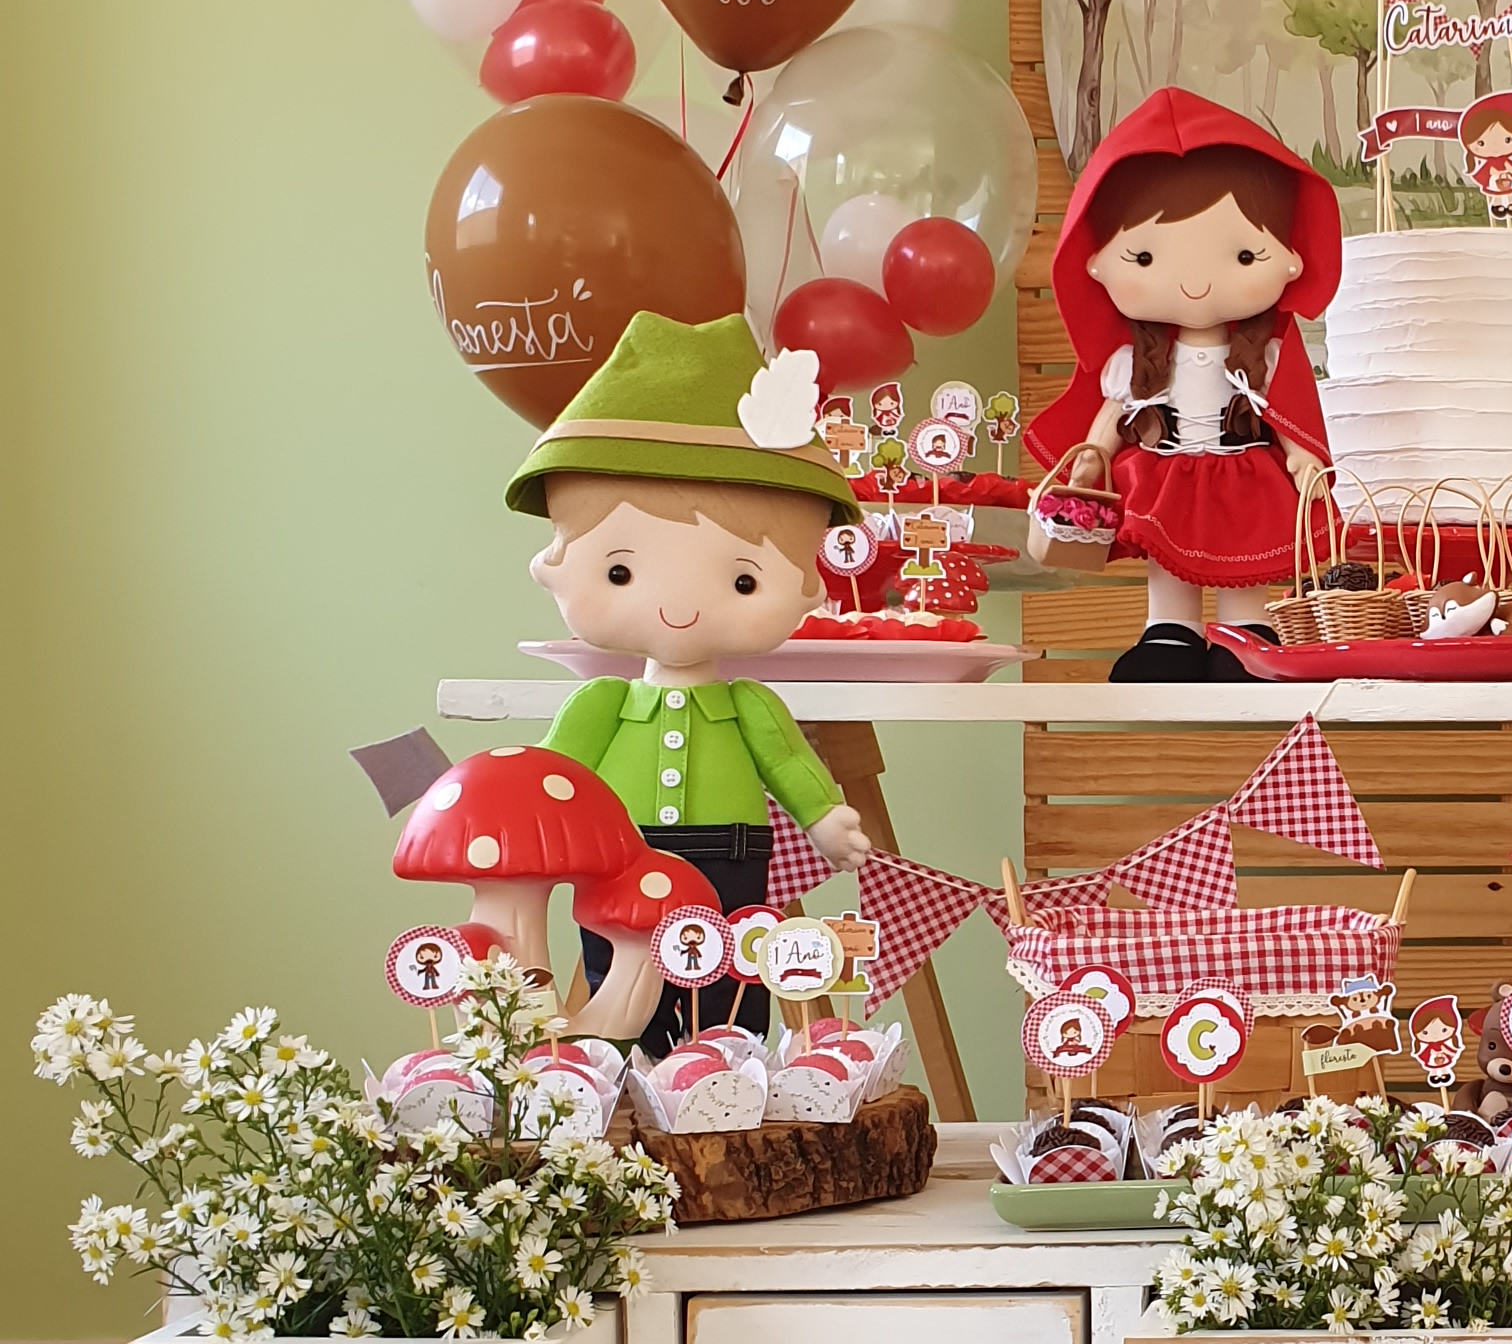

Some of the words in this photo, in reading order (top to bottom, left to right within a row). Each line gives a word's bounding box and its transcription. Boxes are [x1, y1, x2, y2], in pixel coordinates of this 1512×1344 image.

[1425, 118, 1453, 131] ano
[425, 252, 594, 361] loresta
[785, 939, 825, 965] Ano
[1187, 1018, 1220, 1061] C
